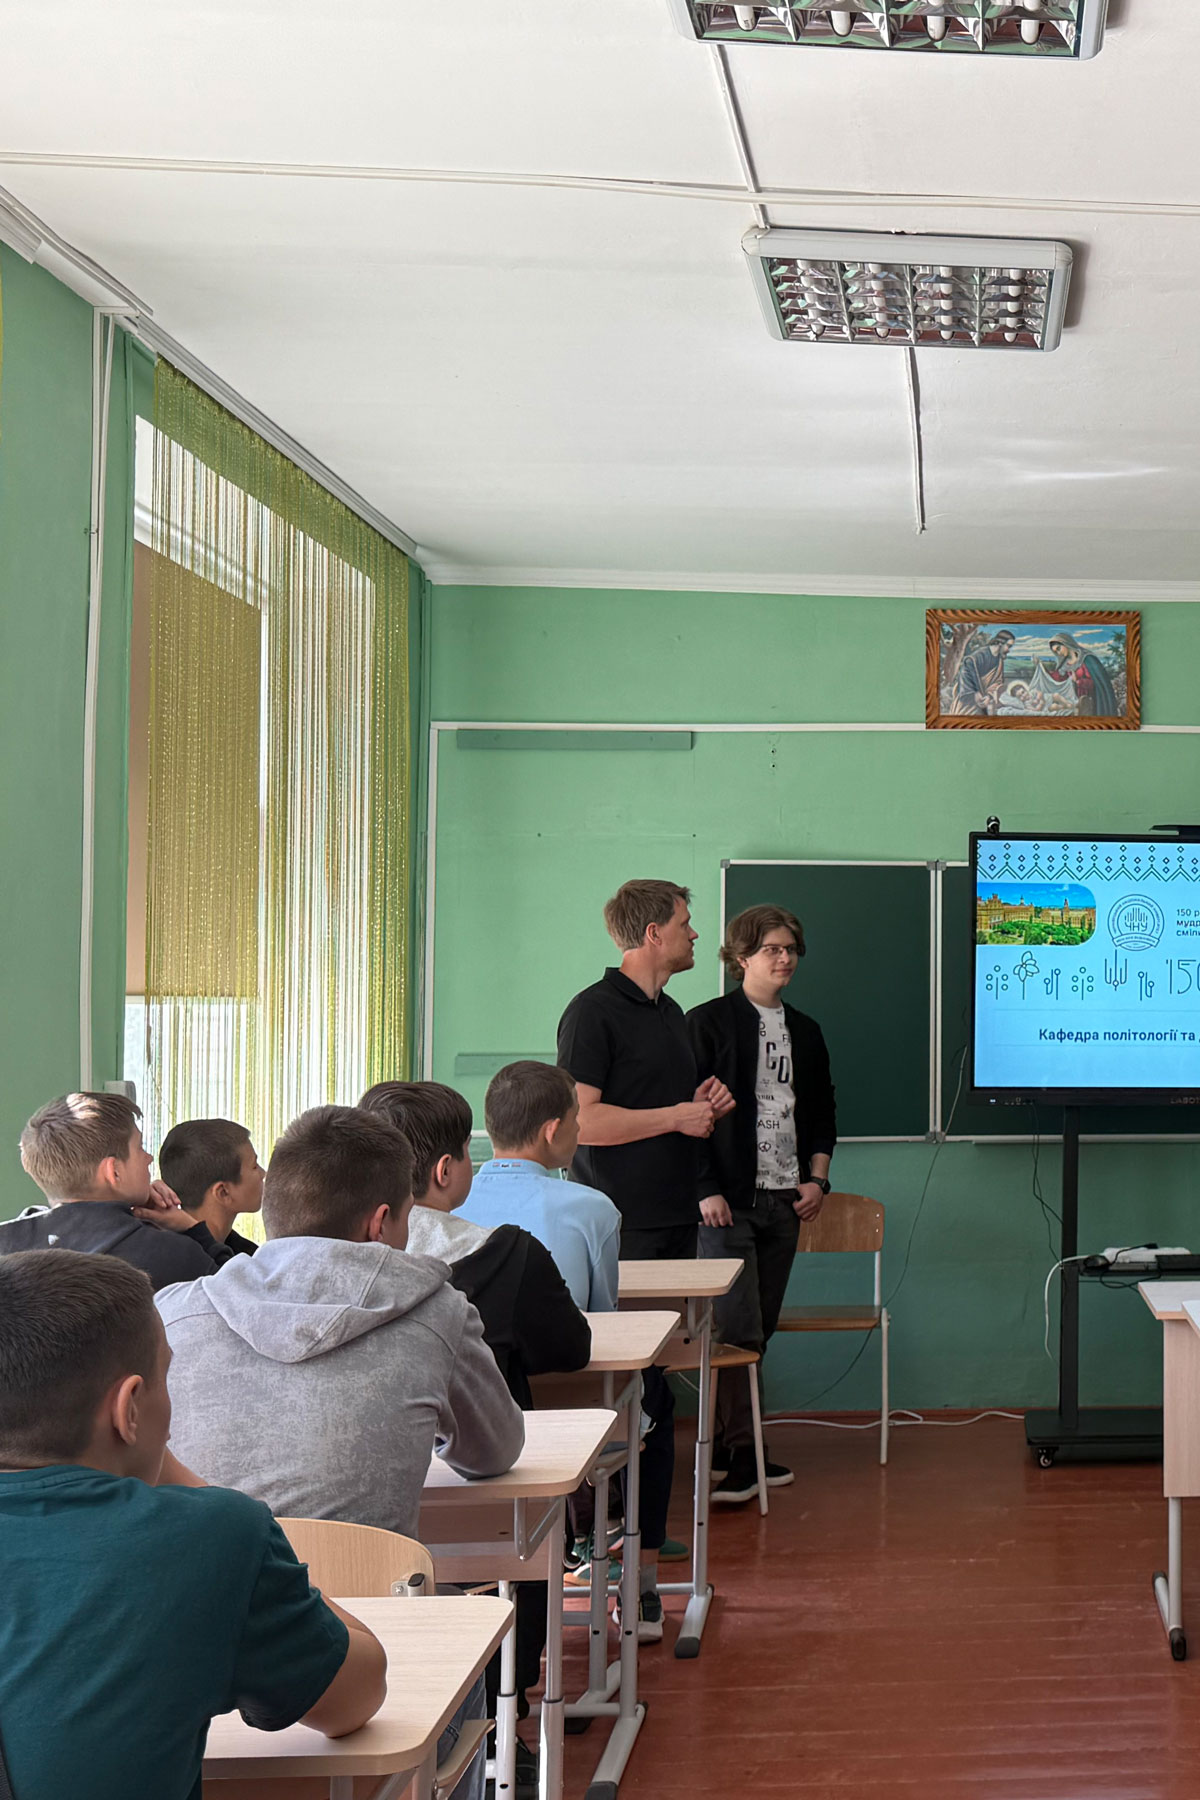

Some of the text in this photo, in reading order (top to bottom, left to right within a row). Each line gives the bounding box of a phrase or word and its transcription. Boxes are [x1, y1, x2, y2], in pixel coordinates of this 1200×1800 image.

[1176, 908, 1192, 917] 150
[1124, 921, 1148, 932] ЧНУ
[1039, 1028, 1099, 1043] Кафедра
[1103, 1029, 1179, 1041] політології
[1180, 1032, 1196, 1041] та
